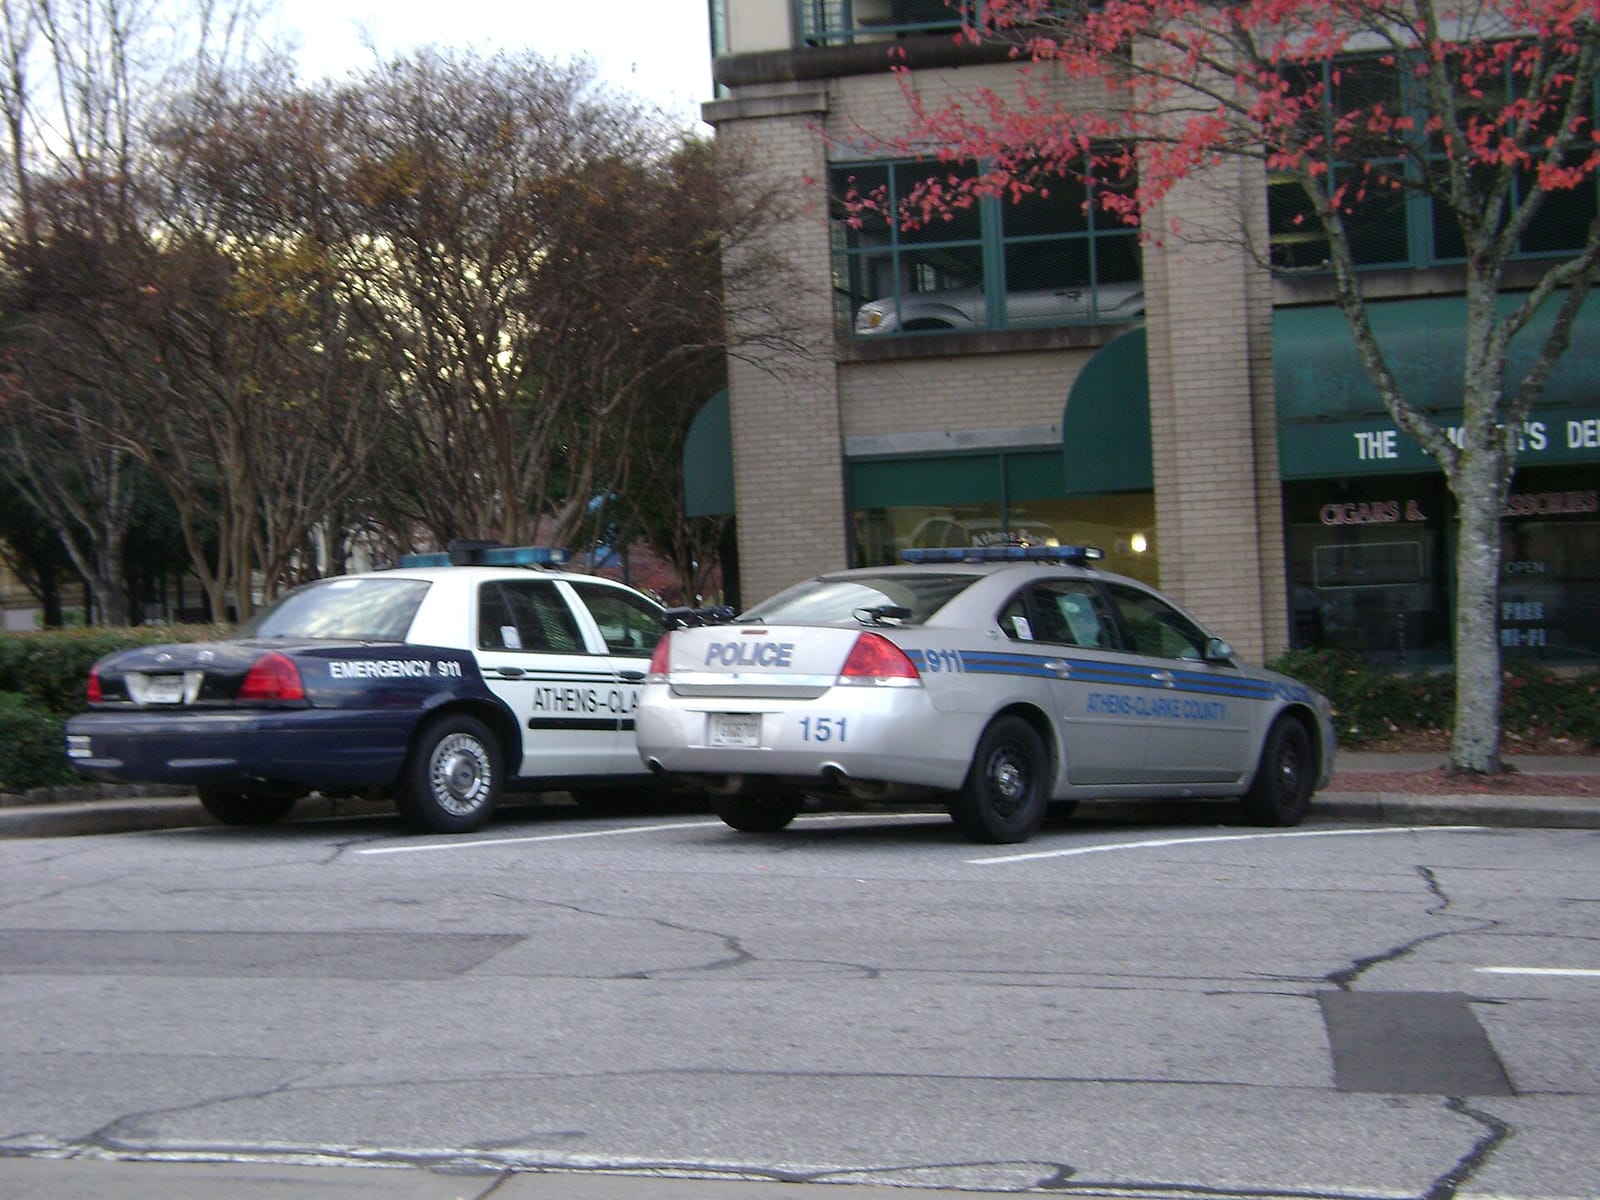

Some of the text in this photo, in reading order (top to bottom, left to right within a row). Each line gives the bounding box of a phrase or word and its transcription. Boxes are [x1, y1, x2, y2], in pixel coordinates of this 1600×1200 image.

[1354, 431, 1398, 459] THE
[1320, 491, 1597, 525] CIGARS & SSORIES
[705, 642, 795, 667] POLICE
[923, 651, 964, 674] 911
[329, 659, 463, 679] EMERGENCY 911
[1087, 693, 1227, 721] ATHENS-CLARKE COUNTY
[799, 717, 847, 742] 151
